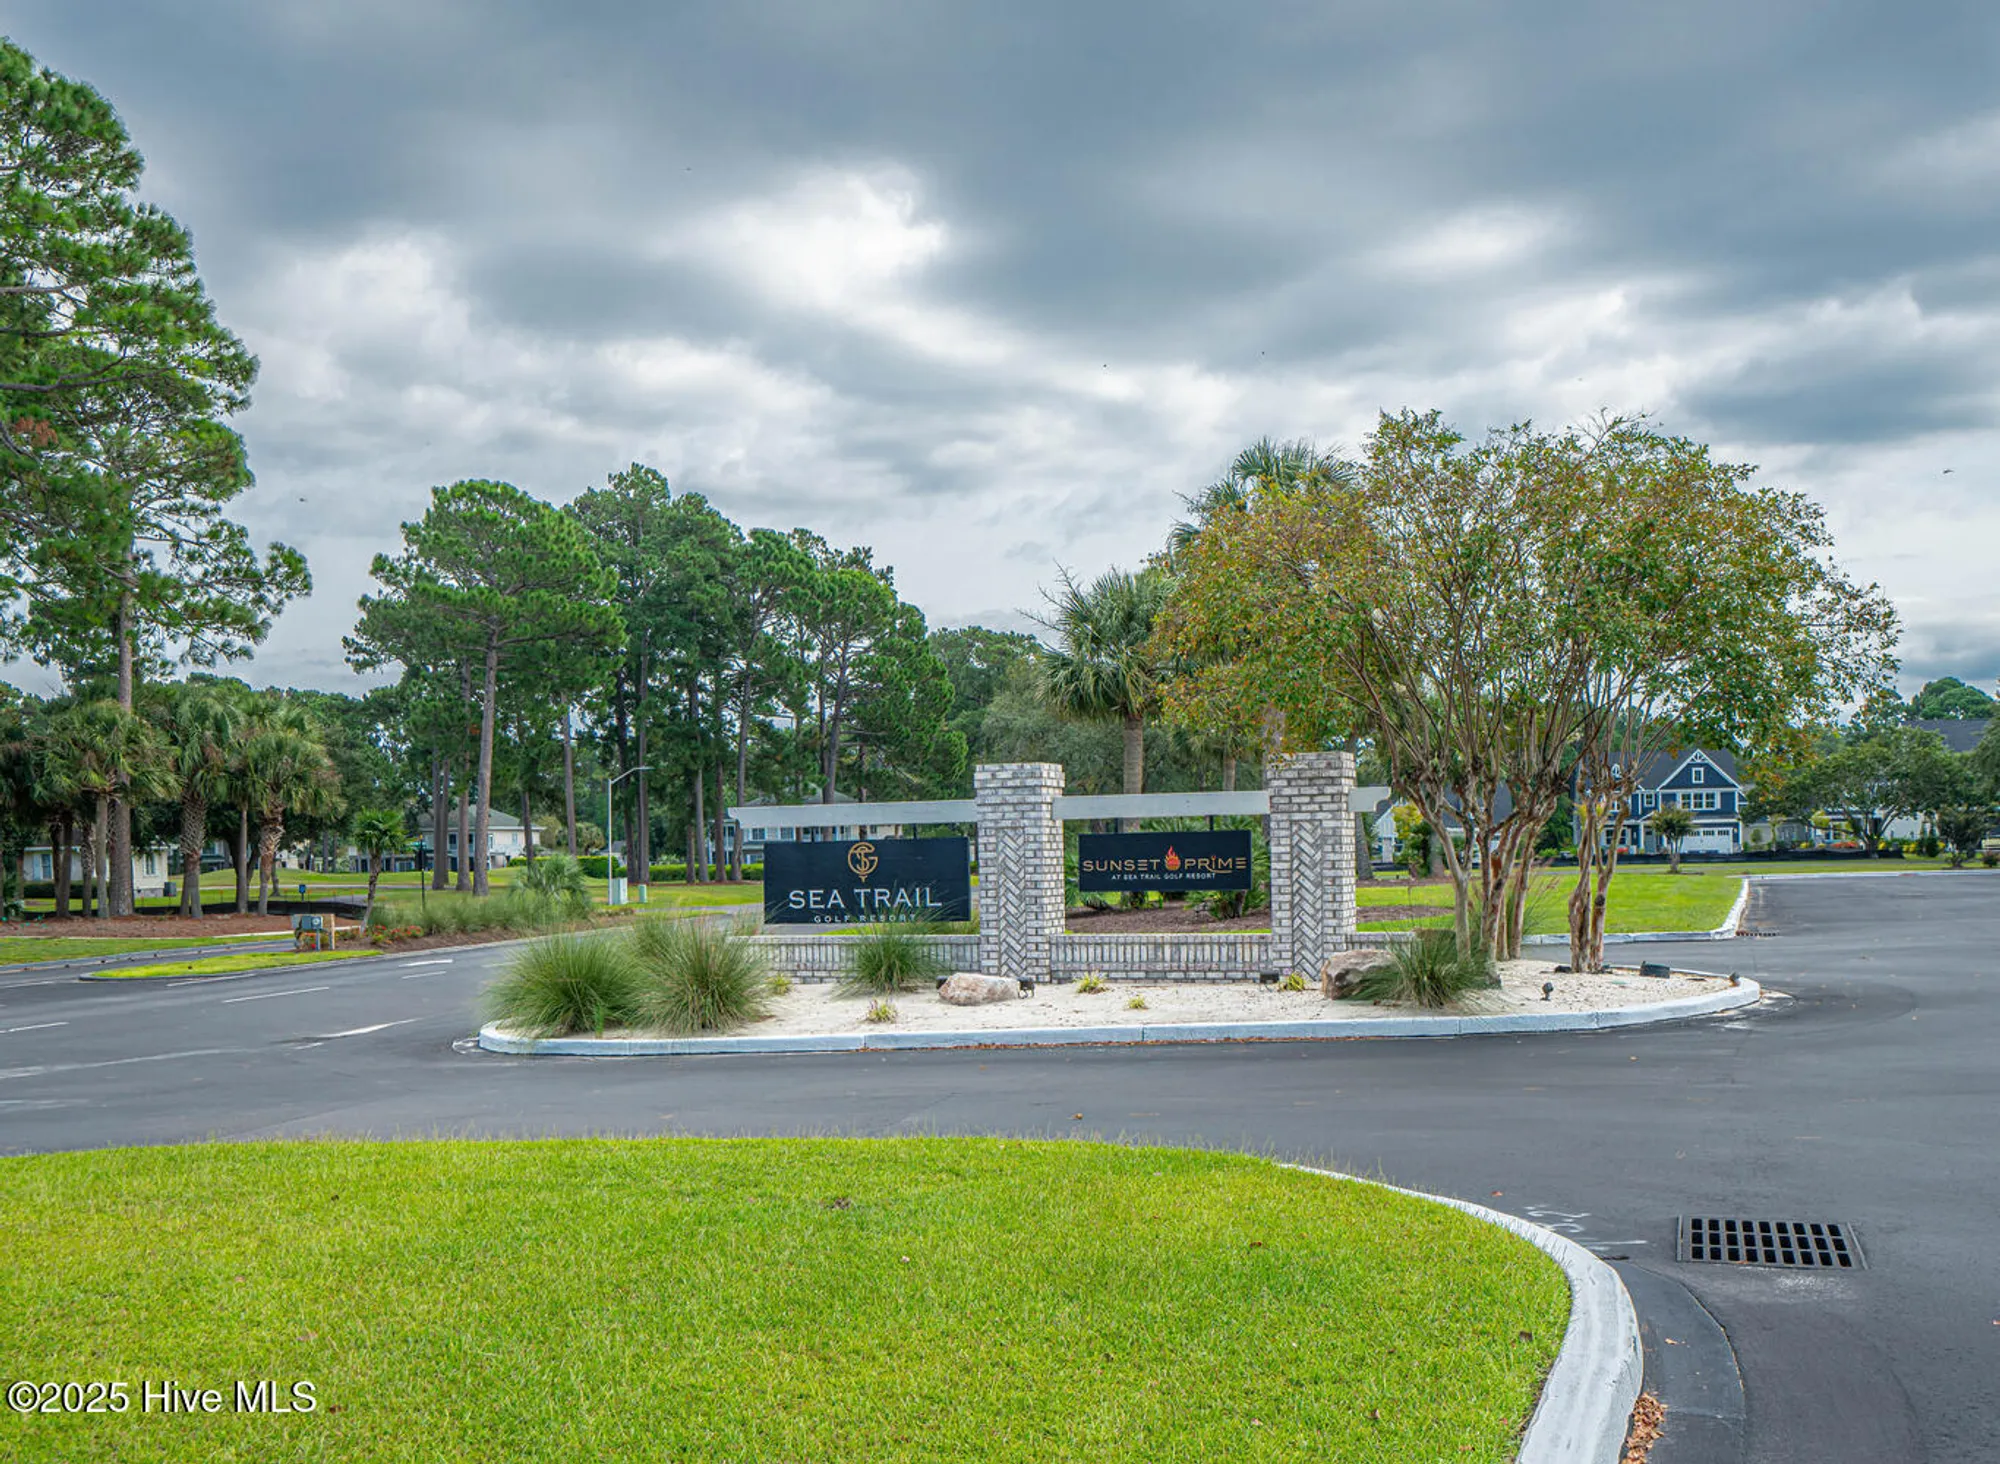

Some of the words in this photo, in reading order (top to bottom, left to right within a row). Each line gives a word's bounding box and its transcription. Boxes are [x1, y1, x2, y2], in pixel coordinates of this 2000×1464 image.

[1082, 859, 1160, 872] SUNSET
[1184, 855, 1247, 874] PRIME
[1140, 872, 1161, 880] TRAIL
[1163, 872, 1183, 880] GOLF
[788, 889, 845, 910] SEA
[853, 887, 943, 909] TRAIL
[813, 914, 851, 924] GOLF
[859, 913, 917, 923] RESORT
